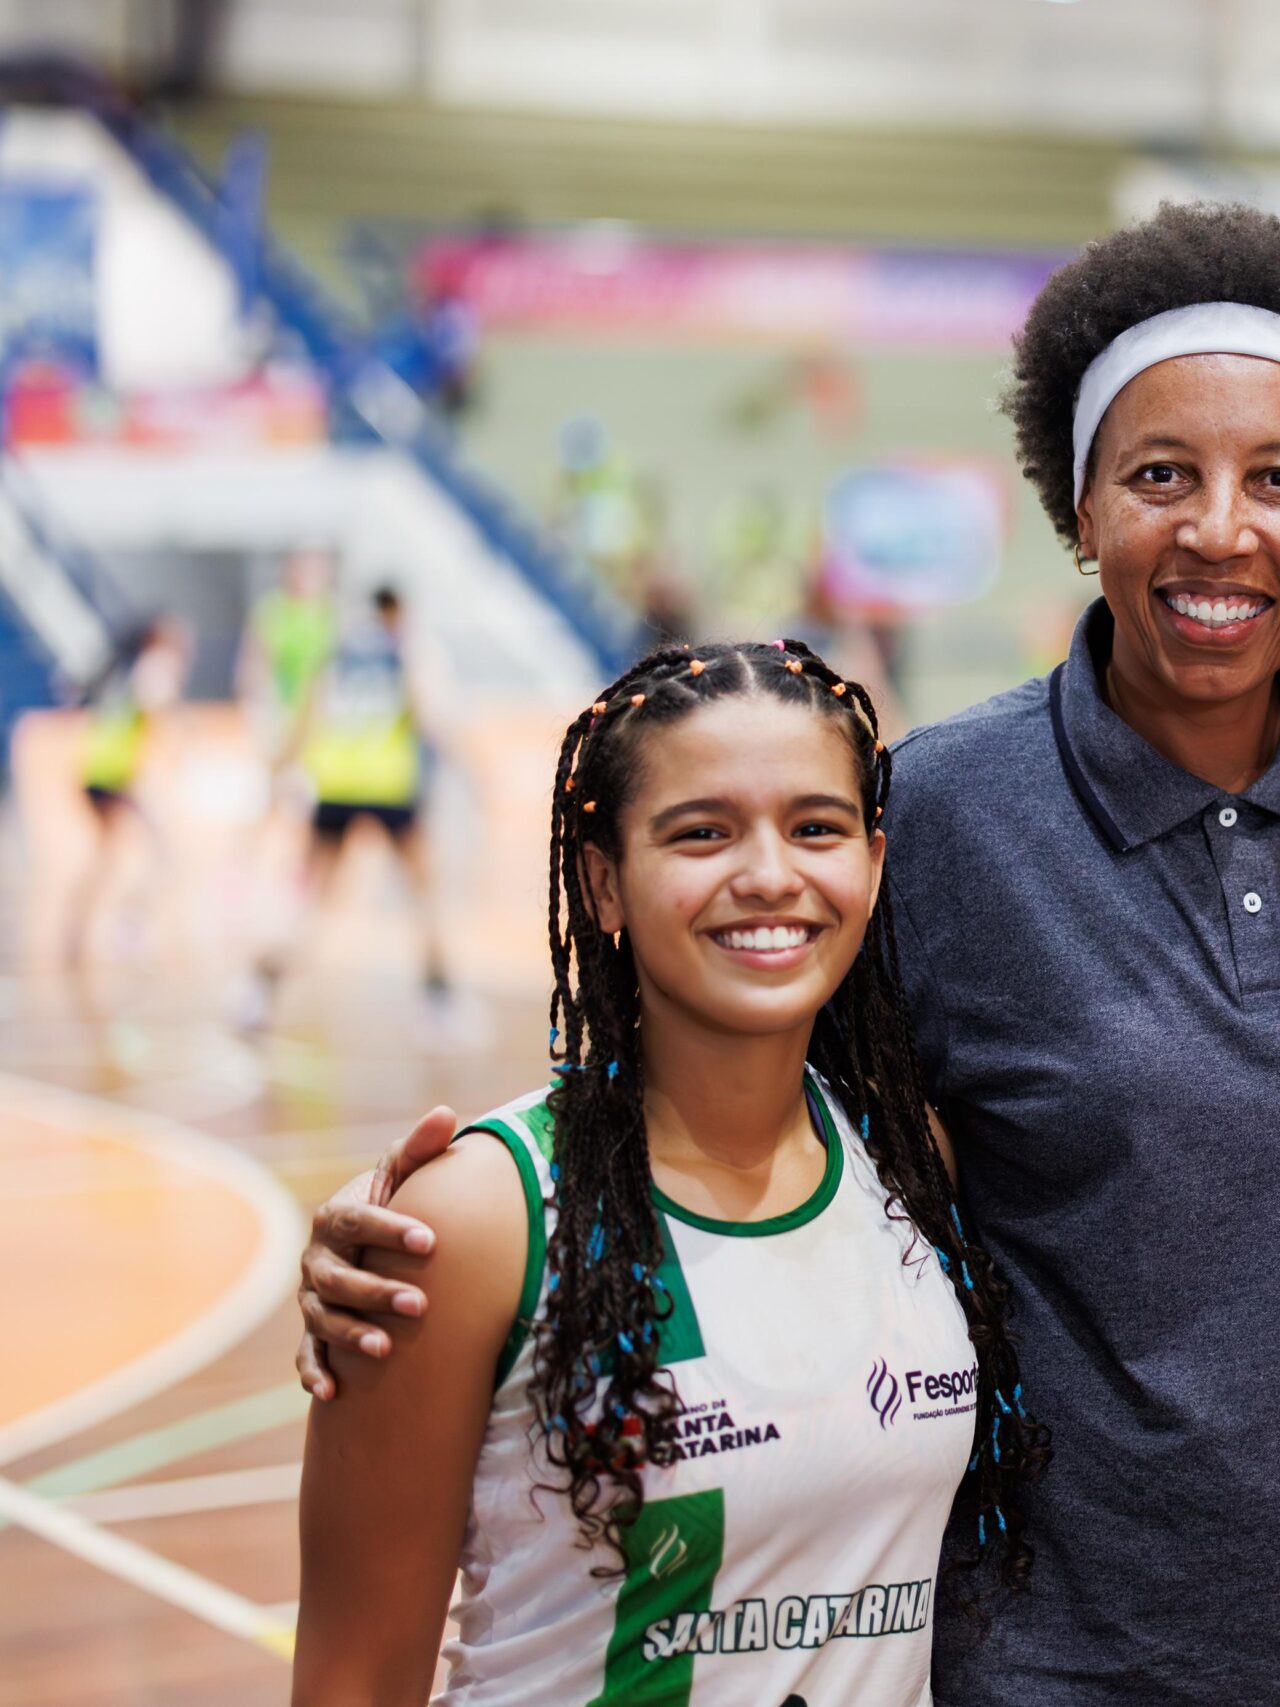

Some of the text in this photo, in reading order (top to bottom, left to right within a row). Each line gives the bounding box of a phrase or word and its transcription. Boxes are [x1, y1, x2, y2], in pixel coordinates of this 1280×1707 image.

[905, 1361, 979, 1405] Fesport
[671, 1412, 735, 1439] ANTA
[913, 1408, 944, 1420] FUNDAÇÃO
[672, 1423, 781, 1460] ATARINA
[642, 1578, 932, 1663] SANTA CATARINA
